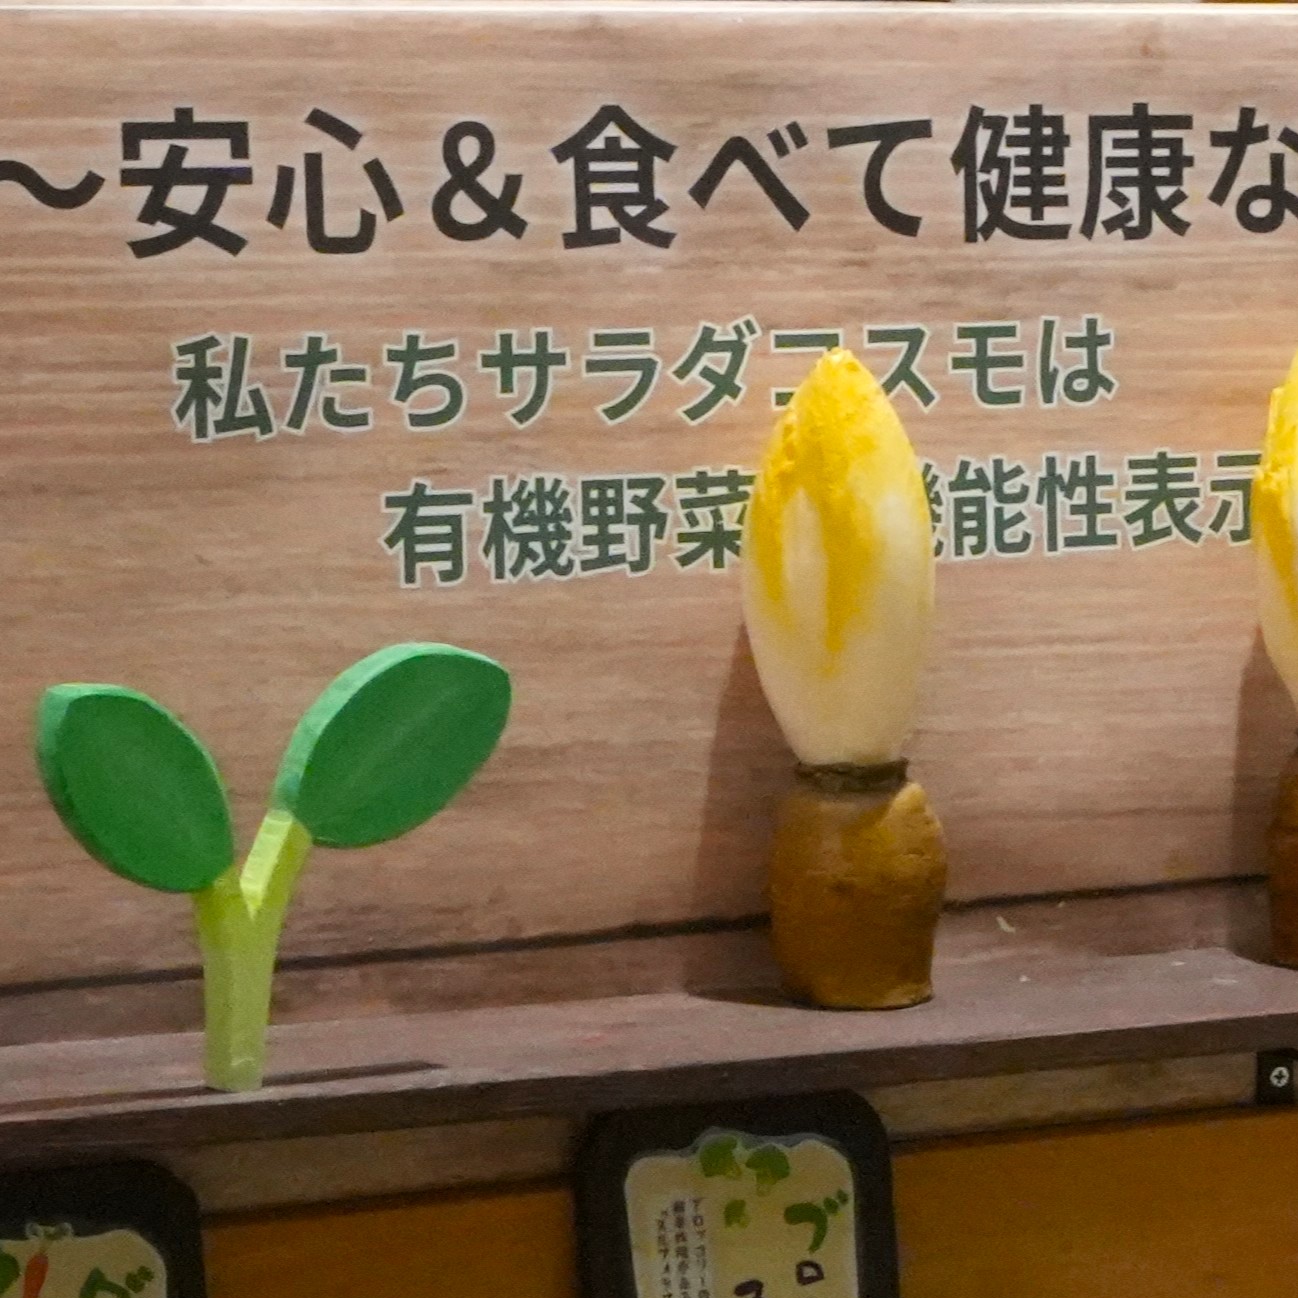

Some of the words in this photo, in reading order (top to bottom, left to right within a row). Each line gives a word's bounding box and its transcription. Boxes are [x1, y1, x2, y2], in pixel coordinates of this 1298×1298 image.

[173, 314, 1115, 442] 私たちサラダコスモは
